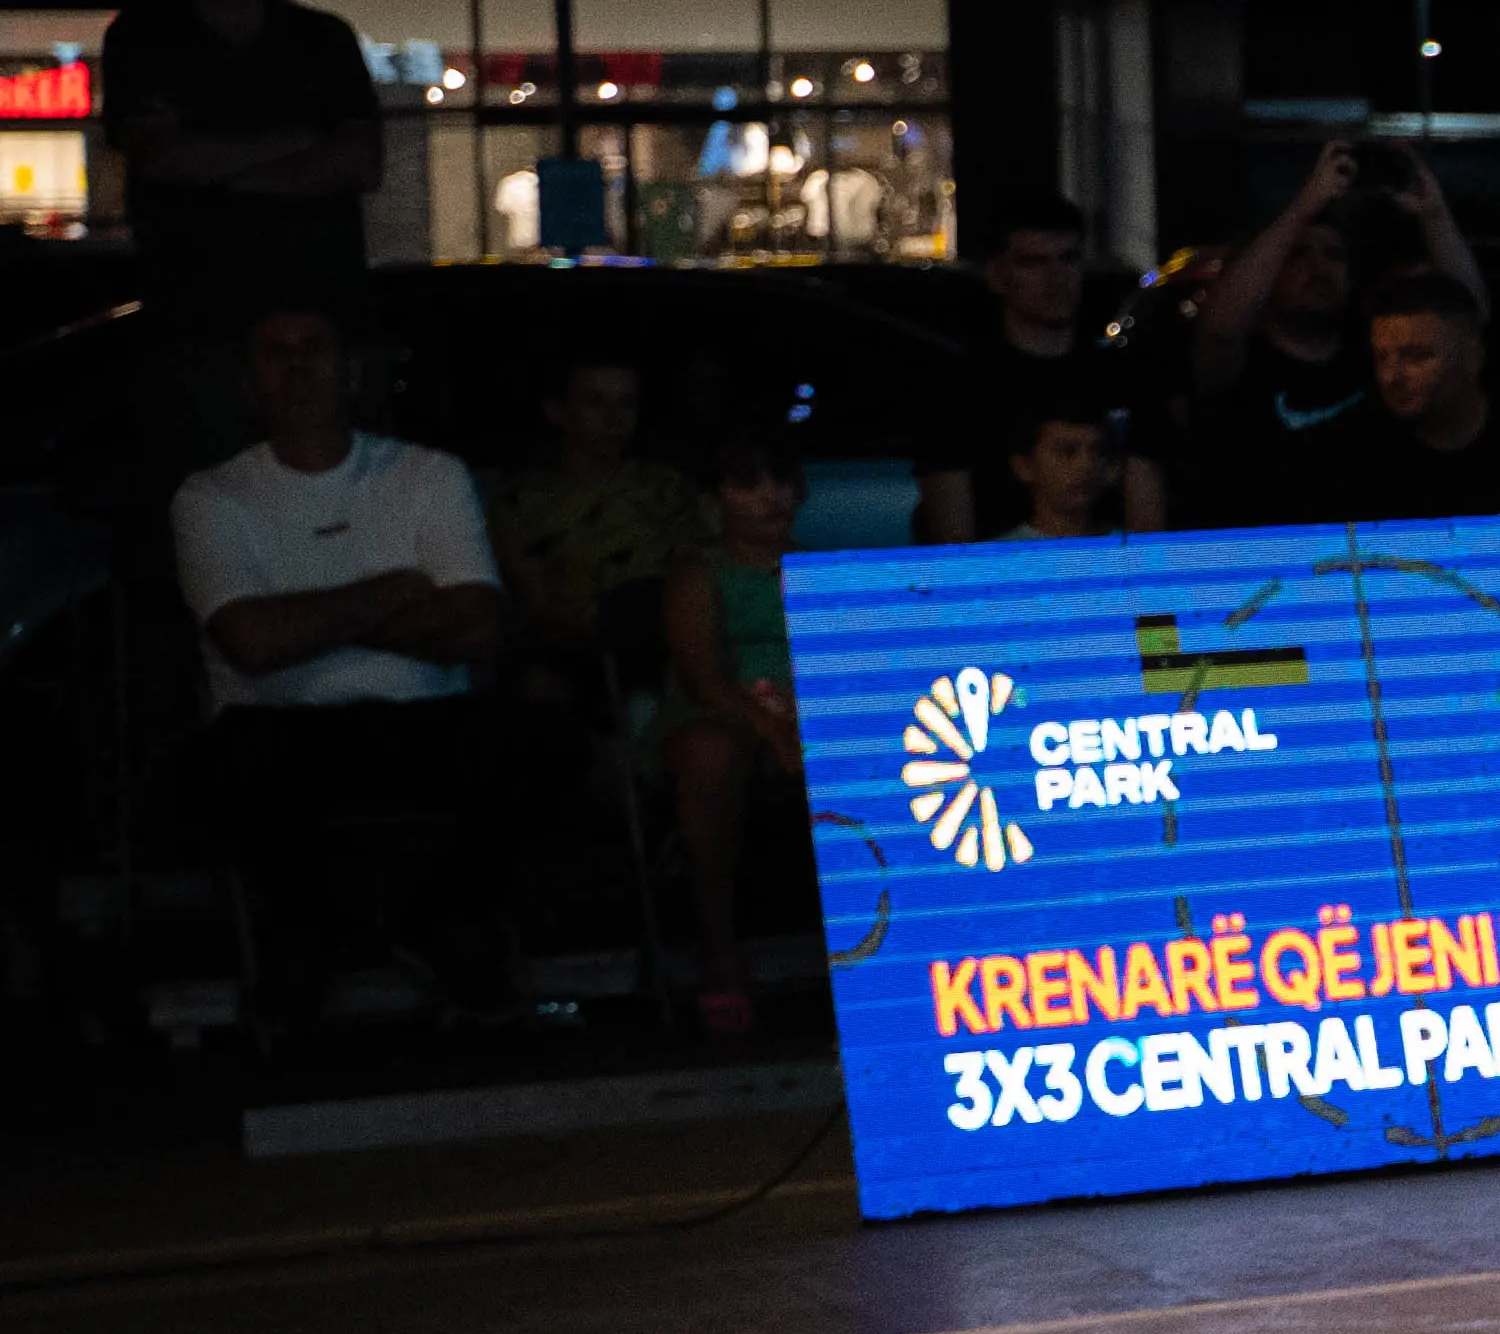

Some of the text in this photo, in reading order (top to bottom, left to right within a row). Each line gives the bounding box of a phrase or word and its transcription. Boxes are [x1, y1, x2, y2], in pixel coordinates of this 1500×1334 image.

[1030, 709, 1278, 766] CENTRAL
[1034, 758, 1180, 811] PARK
[931, 912, 1260, 1037] KRENARË
[1260, 903, 1370, 1011] QË
[1369, 911, 1500, 998] JENI
[943, 1041, 1083, 1131] 3X3
[1085, 1014, 1405, 1117] CENTRAL
